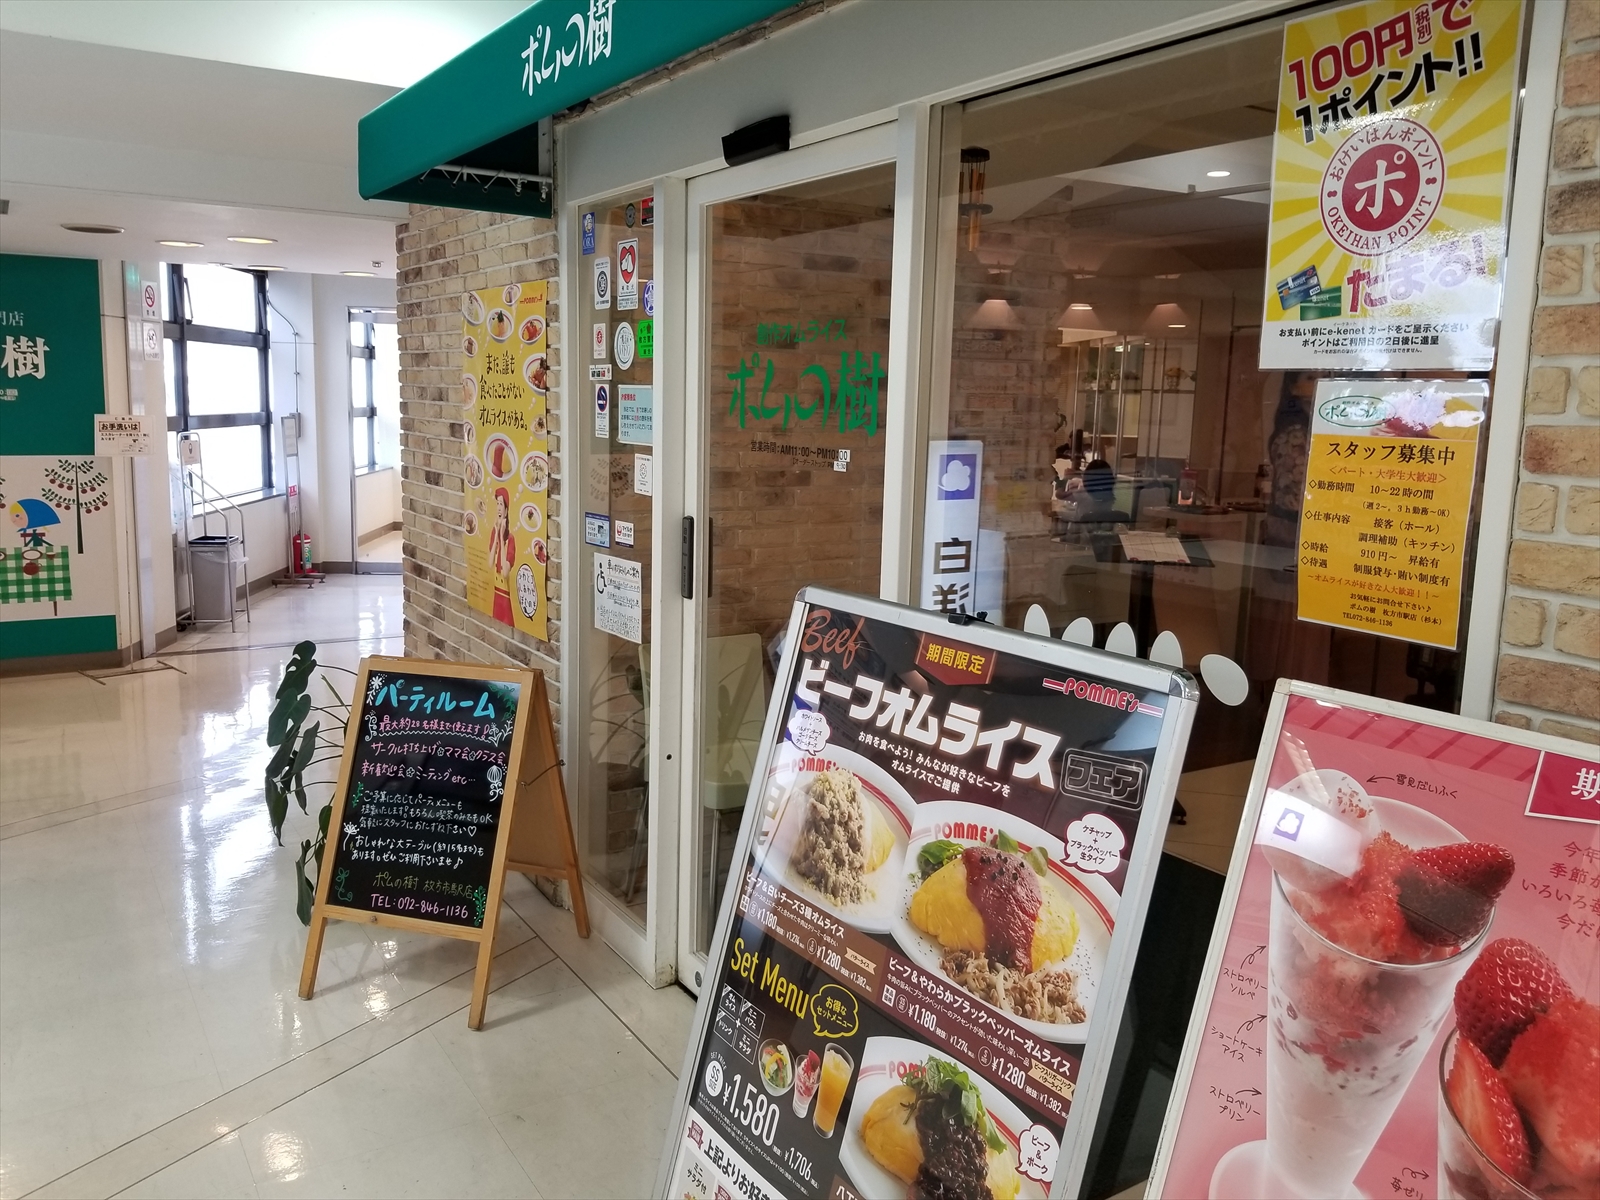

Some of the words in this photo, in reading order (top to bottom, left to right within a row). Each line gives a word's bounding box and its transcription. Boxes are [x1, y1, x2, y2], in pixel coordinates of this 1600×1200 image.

[1289, 11, 1414, 101] 100円
[1329, 124, 1439, 182] おけいはんポイント
[1354, 150, 1406, 219] ポ
[1327, 206, 1381, 250] OKEIHAN
[1388, 195, 1433, 244] POINT
[757, 319, 847, 345] 創作オムライス
[1, 335, 50, 380] 樹
[480, 374, 525, 400] 食べたことがない
[727, 350, 887, 437] ポムの樹
[479, 405, 527, 431] オムライスがある。
[1326, 440, 1456, 466] スタッフ募集中
[1408, 555, 1440, 569] 昇給有
[801, 609, 866, 670] Beef
[925, 643, 986, 675] 期間限定
[375, 679, 496, 719] パーティルーム
[799, 658, 1062, 789] ビーフオムライス
[891, 759, 960, 794] オムライスでご提供
[1067, 755, 1141, 799] フェア
[1083, 825, 1112, 839] ケチャップ
[1070, 840, 1118, 858] ブラックペッパー
[1080, 852, 1105, 865] 生タイプ
[372, 871, 419, 890] ポムの樹
[731, 937, 759, 984] Set
[760, 957, 809, 1020] Menu
[1223, 967, 1267, 990] ストロベリー
[1230, 983, 1256, 1000] ソルベ
[816, 1006, 853, 1029] セットメニュー
[825, 996, 847, 1016] お得な
[908, 1003, 937, 1031] ¥1,180
[991, 1055, 1025, 1090] ¥1,280
[1210, 1025, 1263, 1057] ショートケーキ
[1221, 1043, 1245, 1062] アイス
[710, 1065, 720, 1083] SS
[1209, 1085, 1261, 1116] ストロベリー
[1219, 1104, 1245, 1122] プリン
[722, 1073, 780, 1147] ¥1,580
[784, 1147, 813, 1181] ¥1,706
[1031, 1134, 1050, 1151] ビーフ
[1027, 1156, 1048, 1174] ポーク
